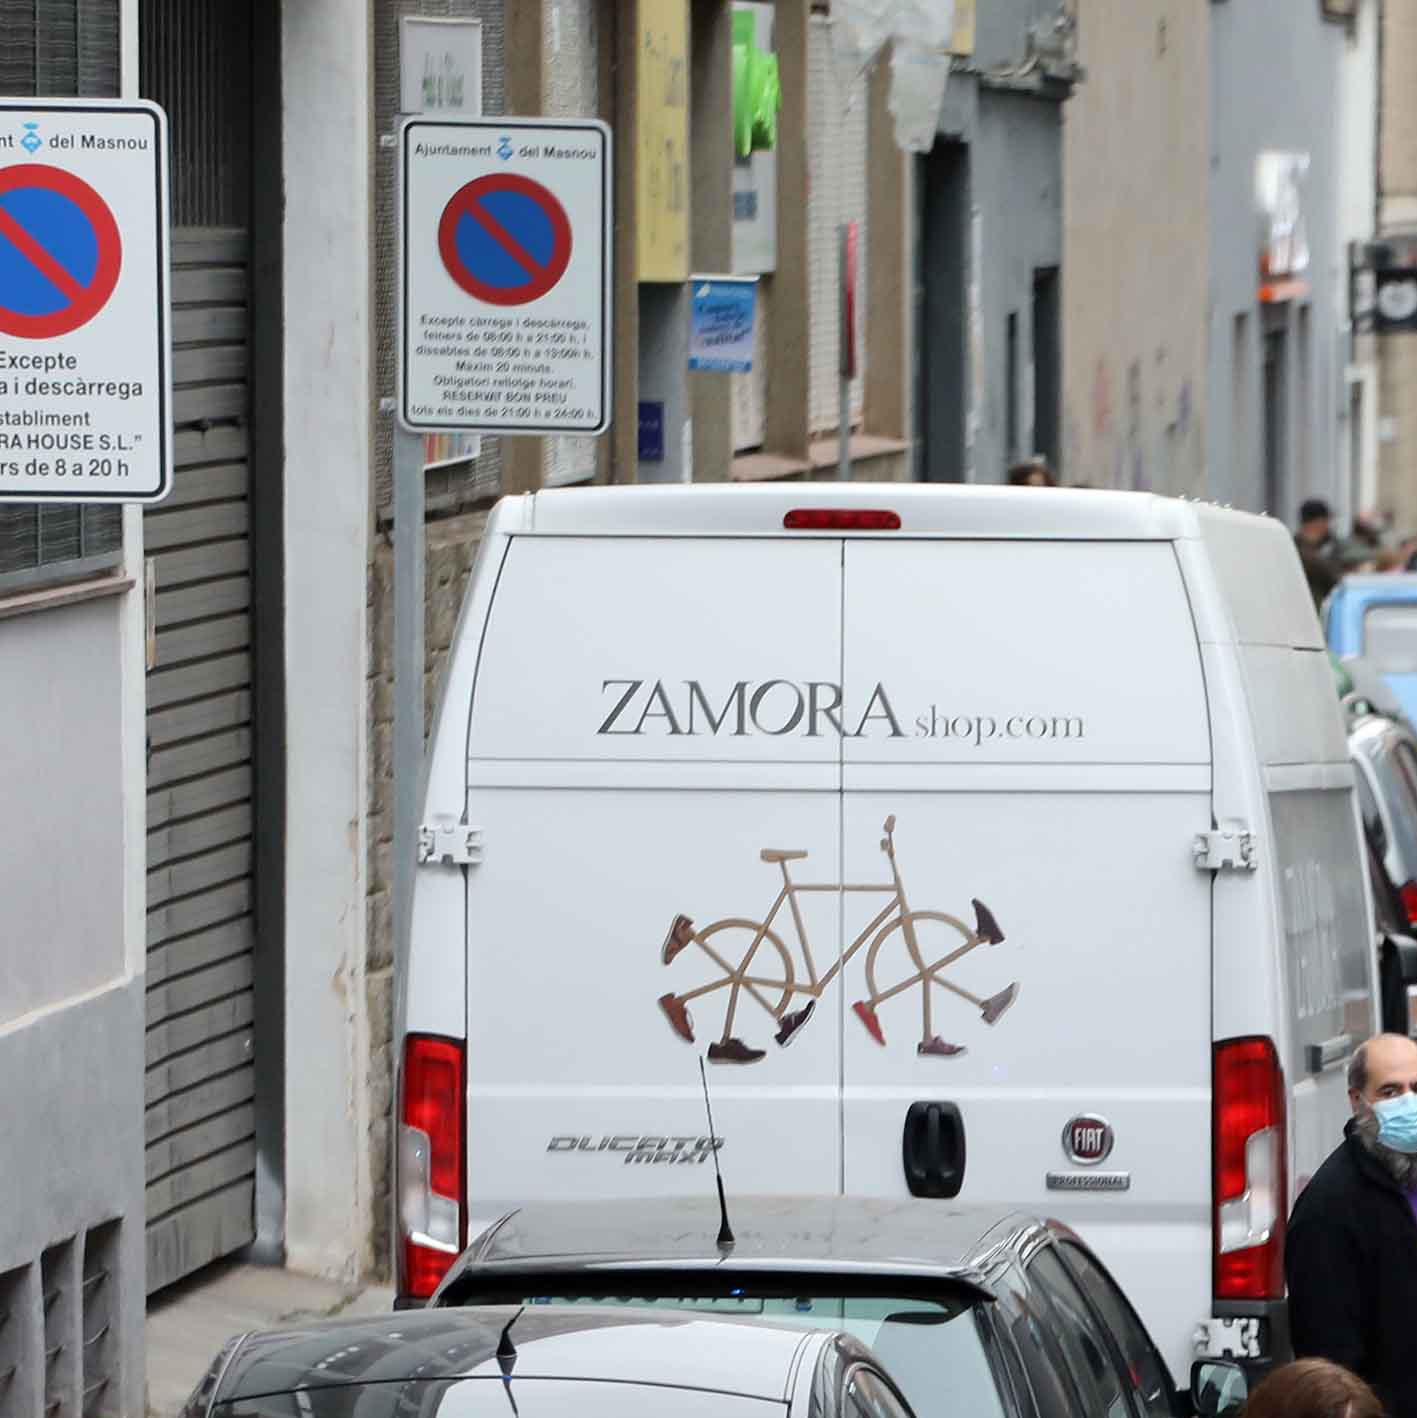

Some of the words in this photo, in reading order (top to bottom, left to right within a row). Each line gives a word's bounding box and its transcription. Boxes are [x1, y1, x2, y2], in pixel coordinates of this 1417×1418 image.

[49, 134, 75, 149] del
[81, 135, 148, 150] Masnou
[415, 143, 492, 157] Ajuntament
[519, 145, 540, 158] del
[544, 146, 597, 160] Masnou
[466, 330, 480, 342] de
[14, 377, 19, 395] i
[25, 376, 143, 400] descàrrega
[27, 433, 94, 451] HOUSE
[25, 458, 50, 477] de
[55, 458, 66, 477] 8
[72, 462, 83, 477] a
[89, 458, 112, 477] 20
[117, 458, 129, 477] h
[596, 679, 907, 738] ZAMORA
[914, 703, 1086, 747] shop.com
[546, 1136, 725, 1152] DUCATO
[1074, 1127, 1105, 1153] FIAT
